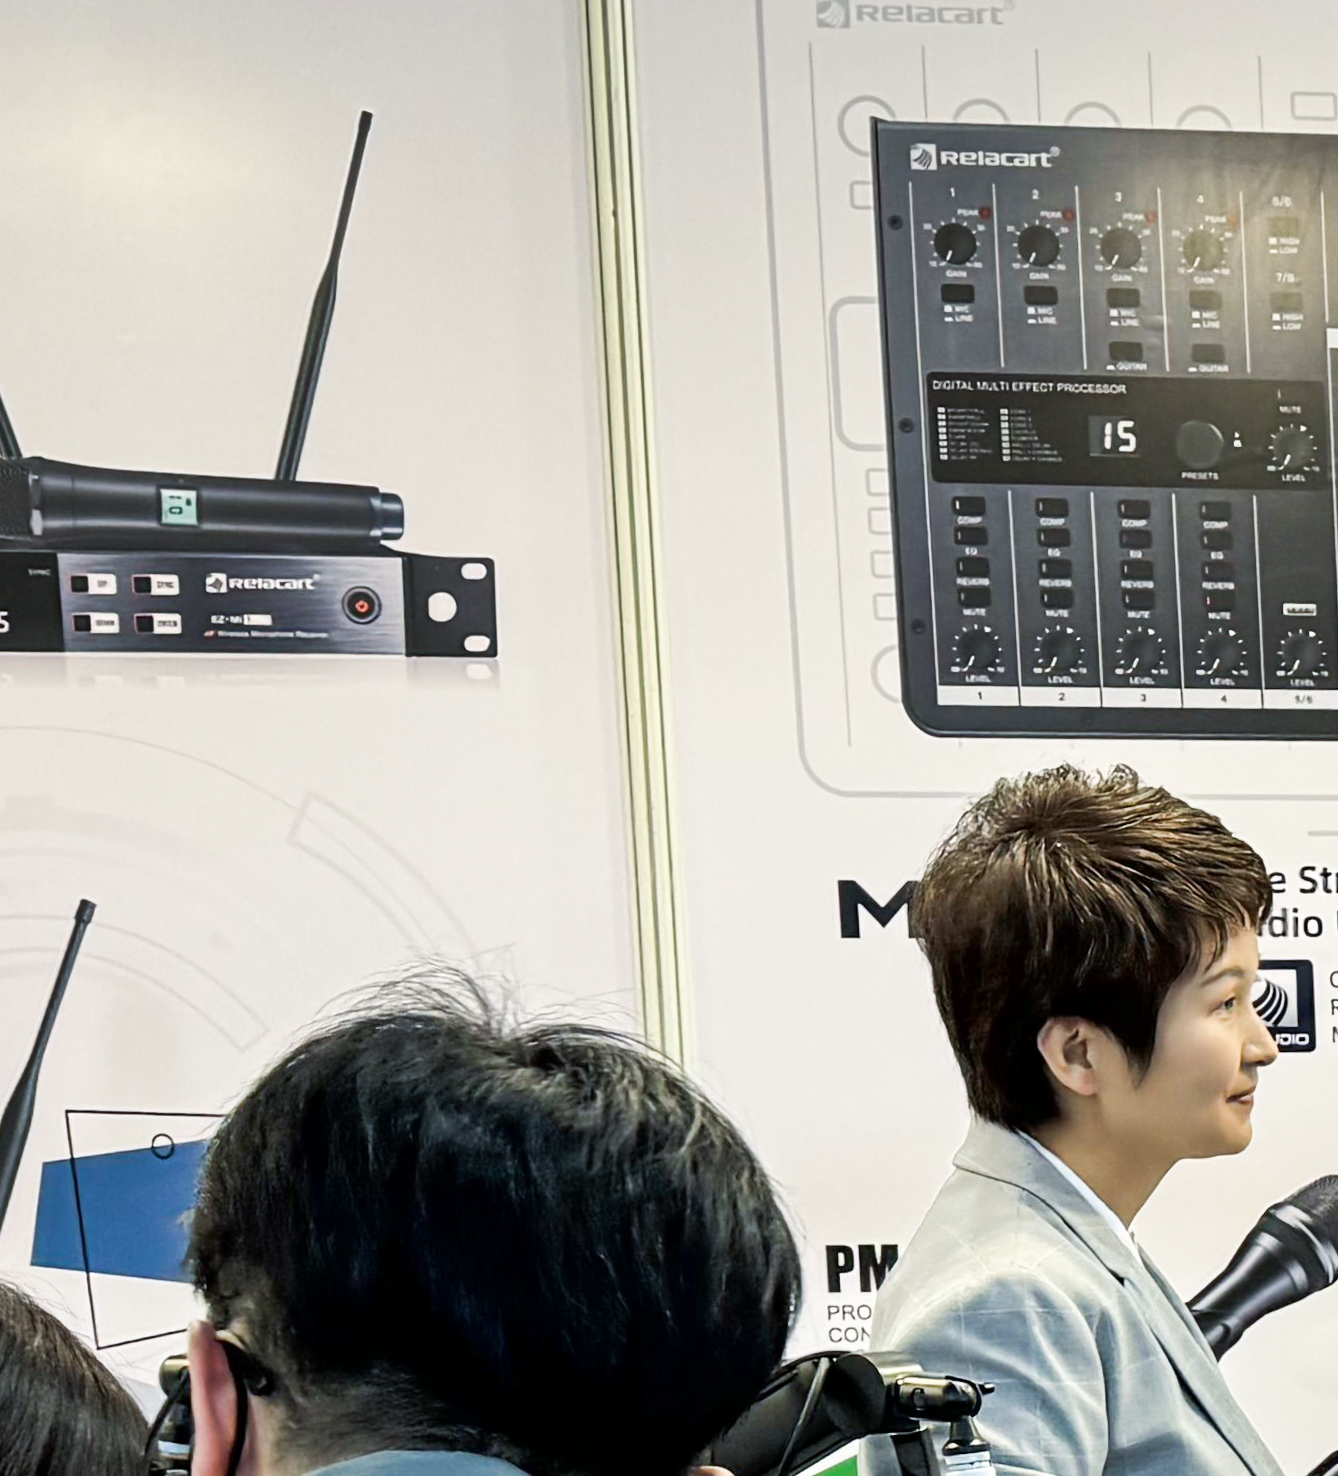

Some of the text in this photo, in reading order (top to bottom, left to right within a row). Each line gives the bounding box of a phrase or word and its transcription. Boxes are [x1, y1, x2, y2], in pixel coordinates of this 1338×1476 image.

[856, 3, 1004, 25] Relacart
[940, 149, 1053, 168] Relacart
[933, 380, 973, 391] DIGITAL
[1012, 382, 1054, 393] EFFECT
[1057, 384, 1127, 395] PROCESSOR
[1104, 420, 1136, 452] 15
[229, 577, 316, 590] Relacart
